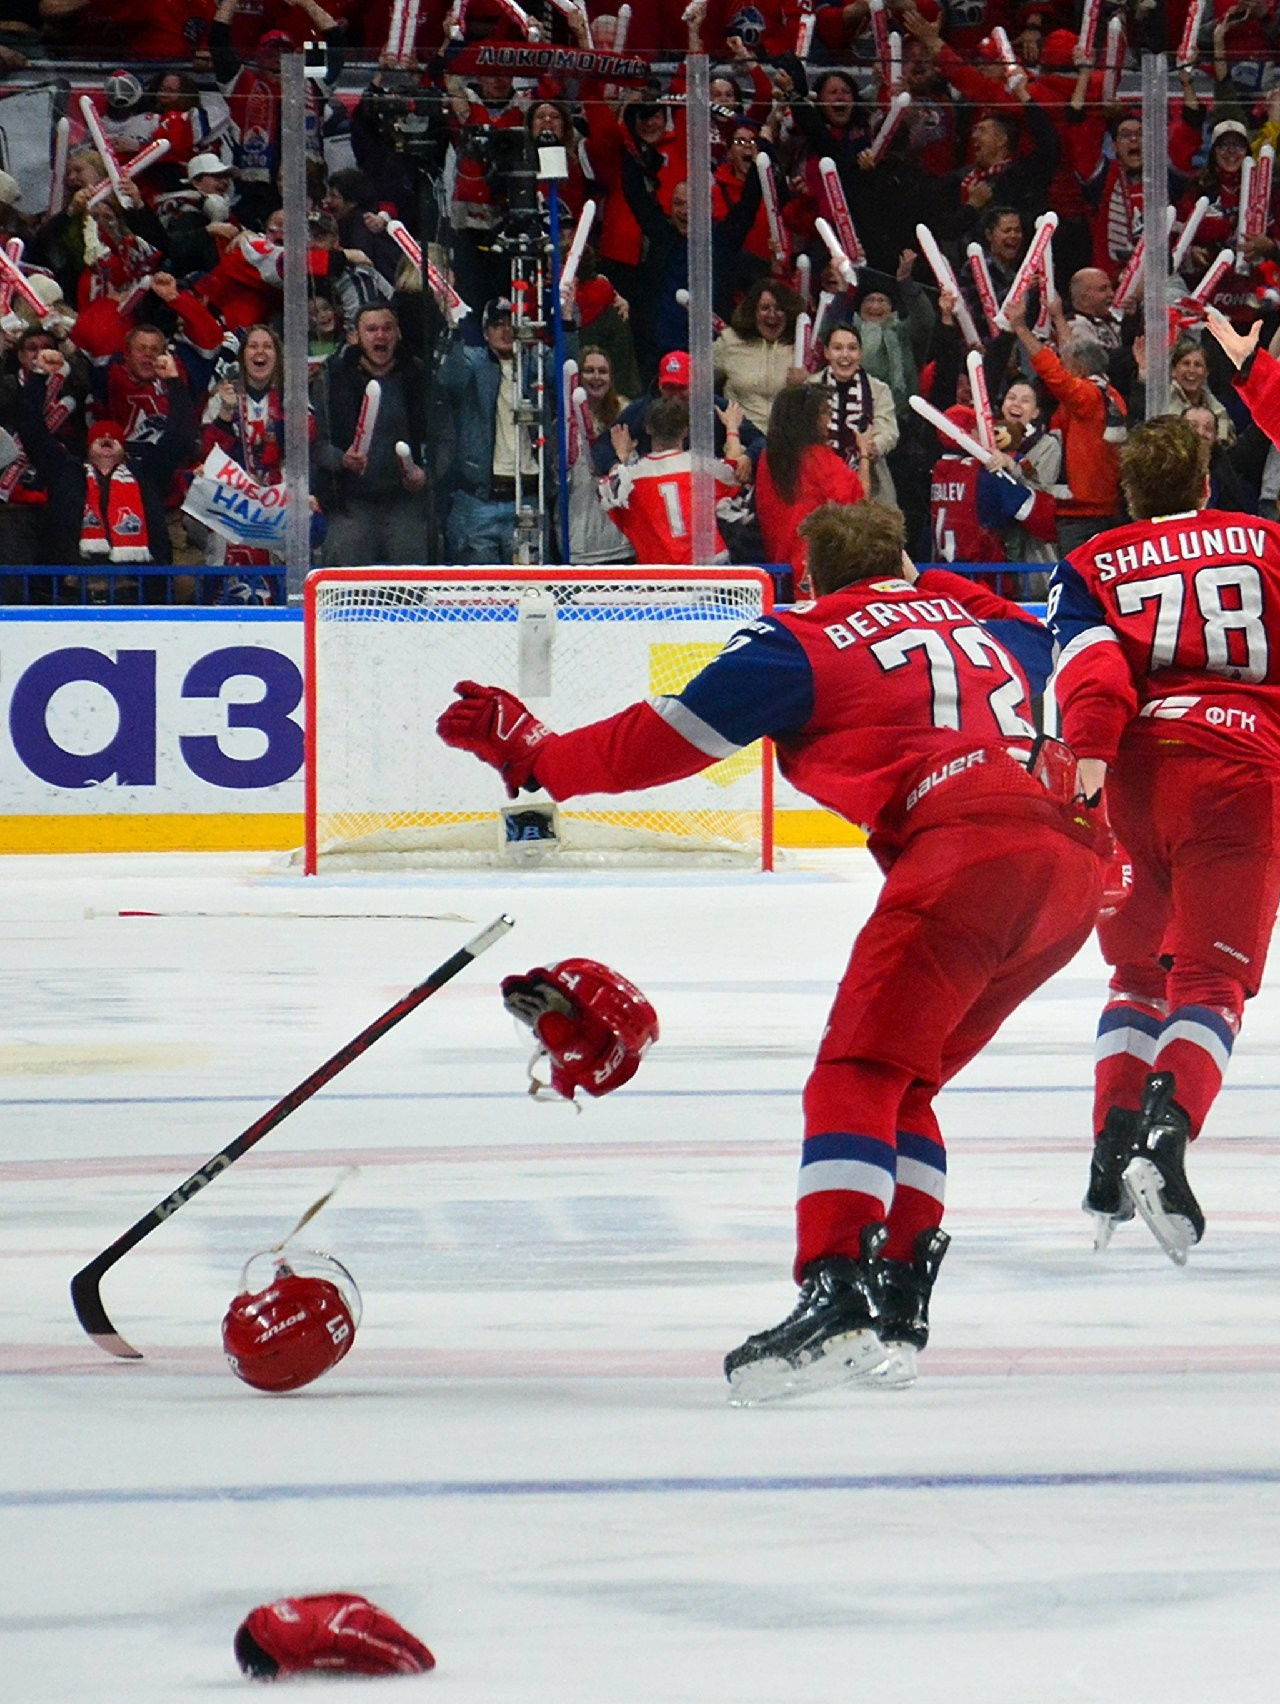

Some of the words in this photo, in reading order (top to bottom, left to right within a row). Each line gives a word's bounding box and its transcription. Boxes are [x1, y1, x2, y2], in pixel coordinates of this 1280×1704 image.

[658, 481, 687, 537] 1
[1094, 526, 1266, 582] SHALUNOV
[1114, 563, 1268, 685] 78
[870, 627, 1036, 738] 72
[0, 645, 305, 789] аз
[1205, 706, 1256, 742] ФГК
[906, 749, 987, 812] BAUER
[1121, 864, 1133, 888] 78
[154, 1153, 233, 1222] CCM
